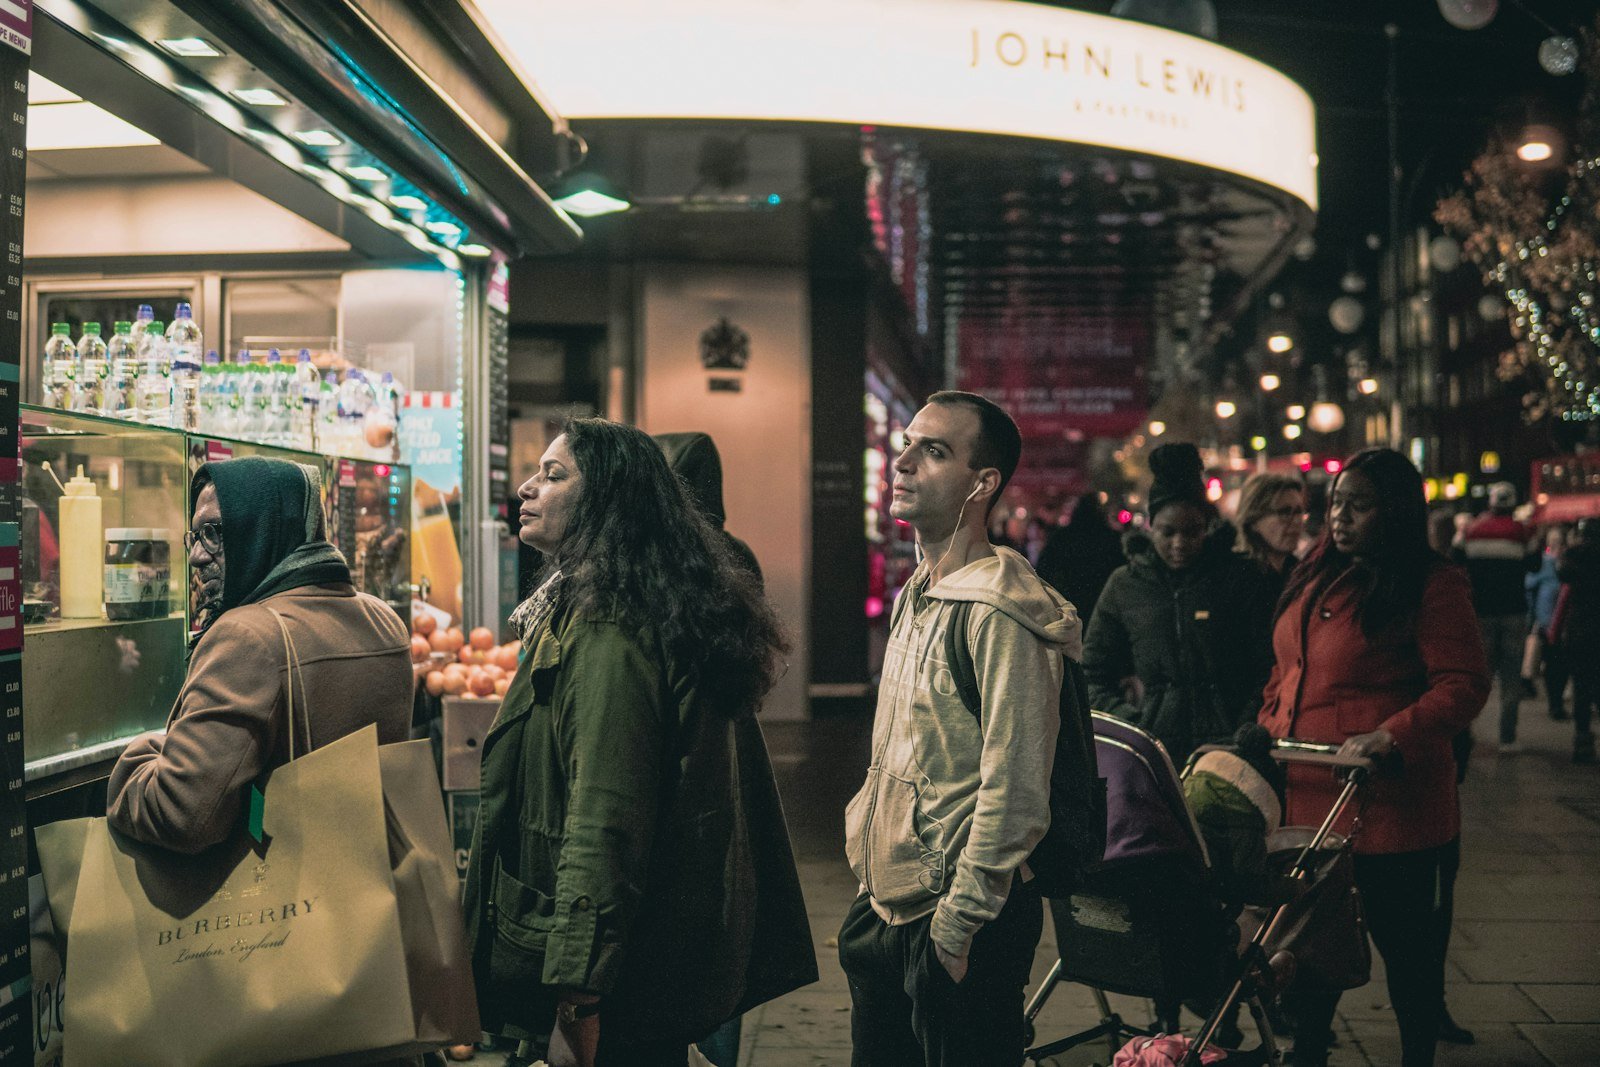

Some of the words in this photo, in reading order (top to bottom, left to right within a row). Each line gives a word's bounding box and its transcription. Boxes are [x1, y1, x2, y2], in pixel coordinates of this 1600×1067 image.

[9, 31, 27, 50] MENU
[970, 29, 1112, 79] JOHN
[1134, 53, 1247, 112] LEWIS
[10, 194, 22, 206] £5.00
[10, 205, 22, 217] £5.25
[9, 242, 21, 254] £5.00
[8, 253, 20, 265] £5.25
[6, 309, 19, 321] £5.00
[416, 448, 453, 465] JUICE
[156, 896, 319, 947] BURBERRY
[172, 942, 226, 965] London,
[229, 930, 292, 963] England
